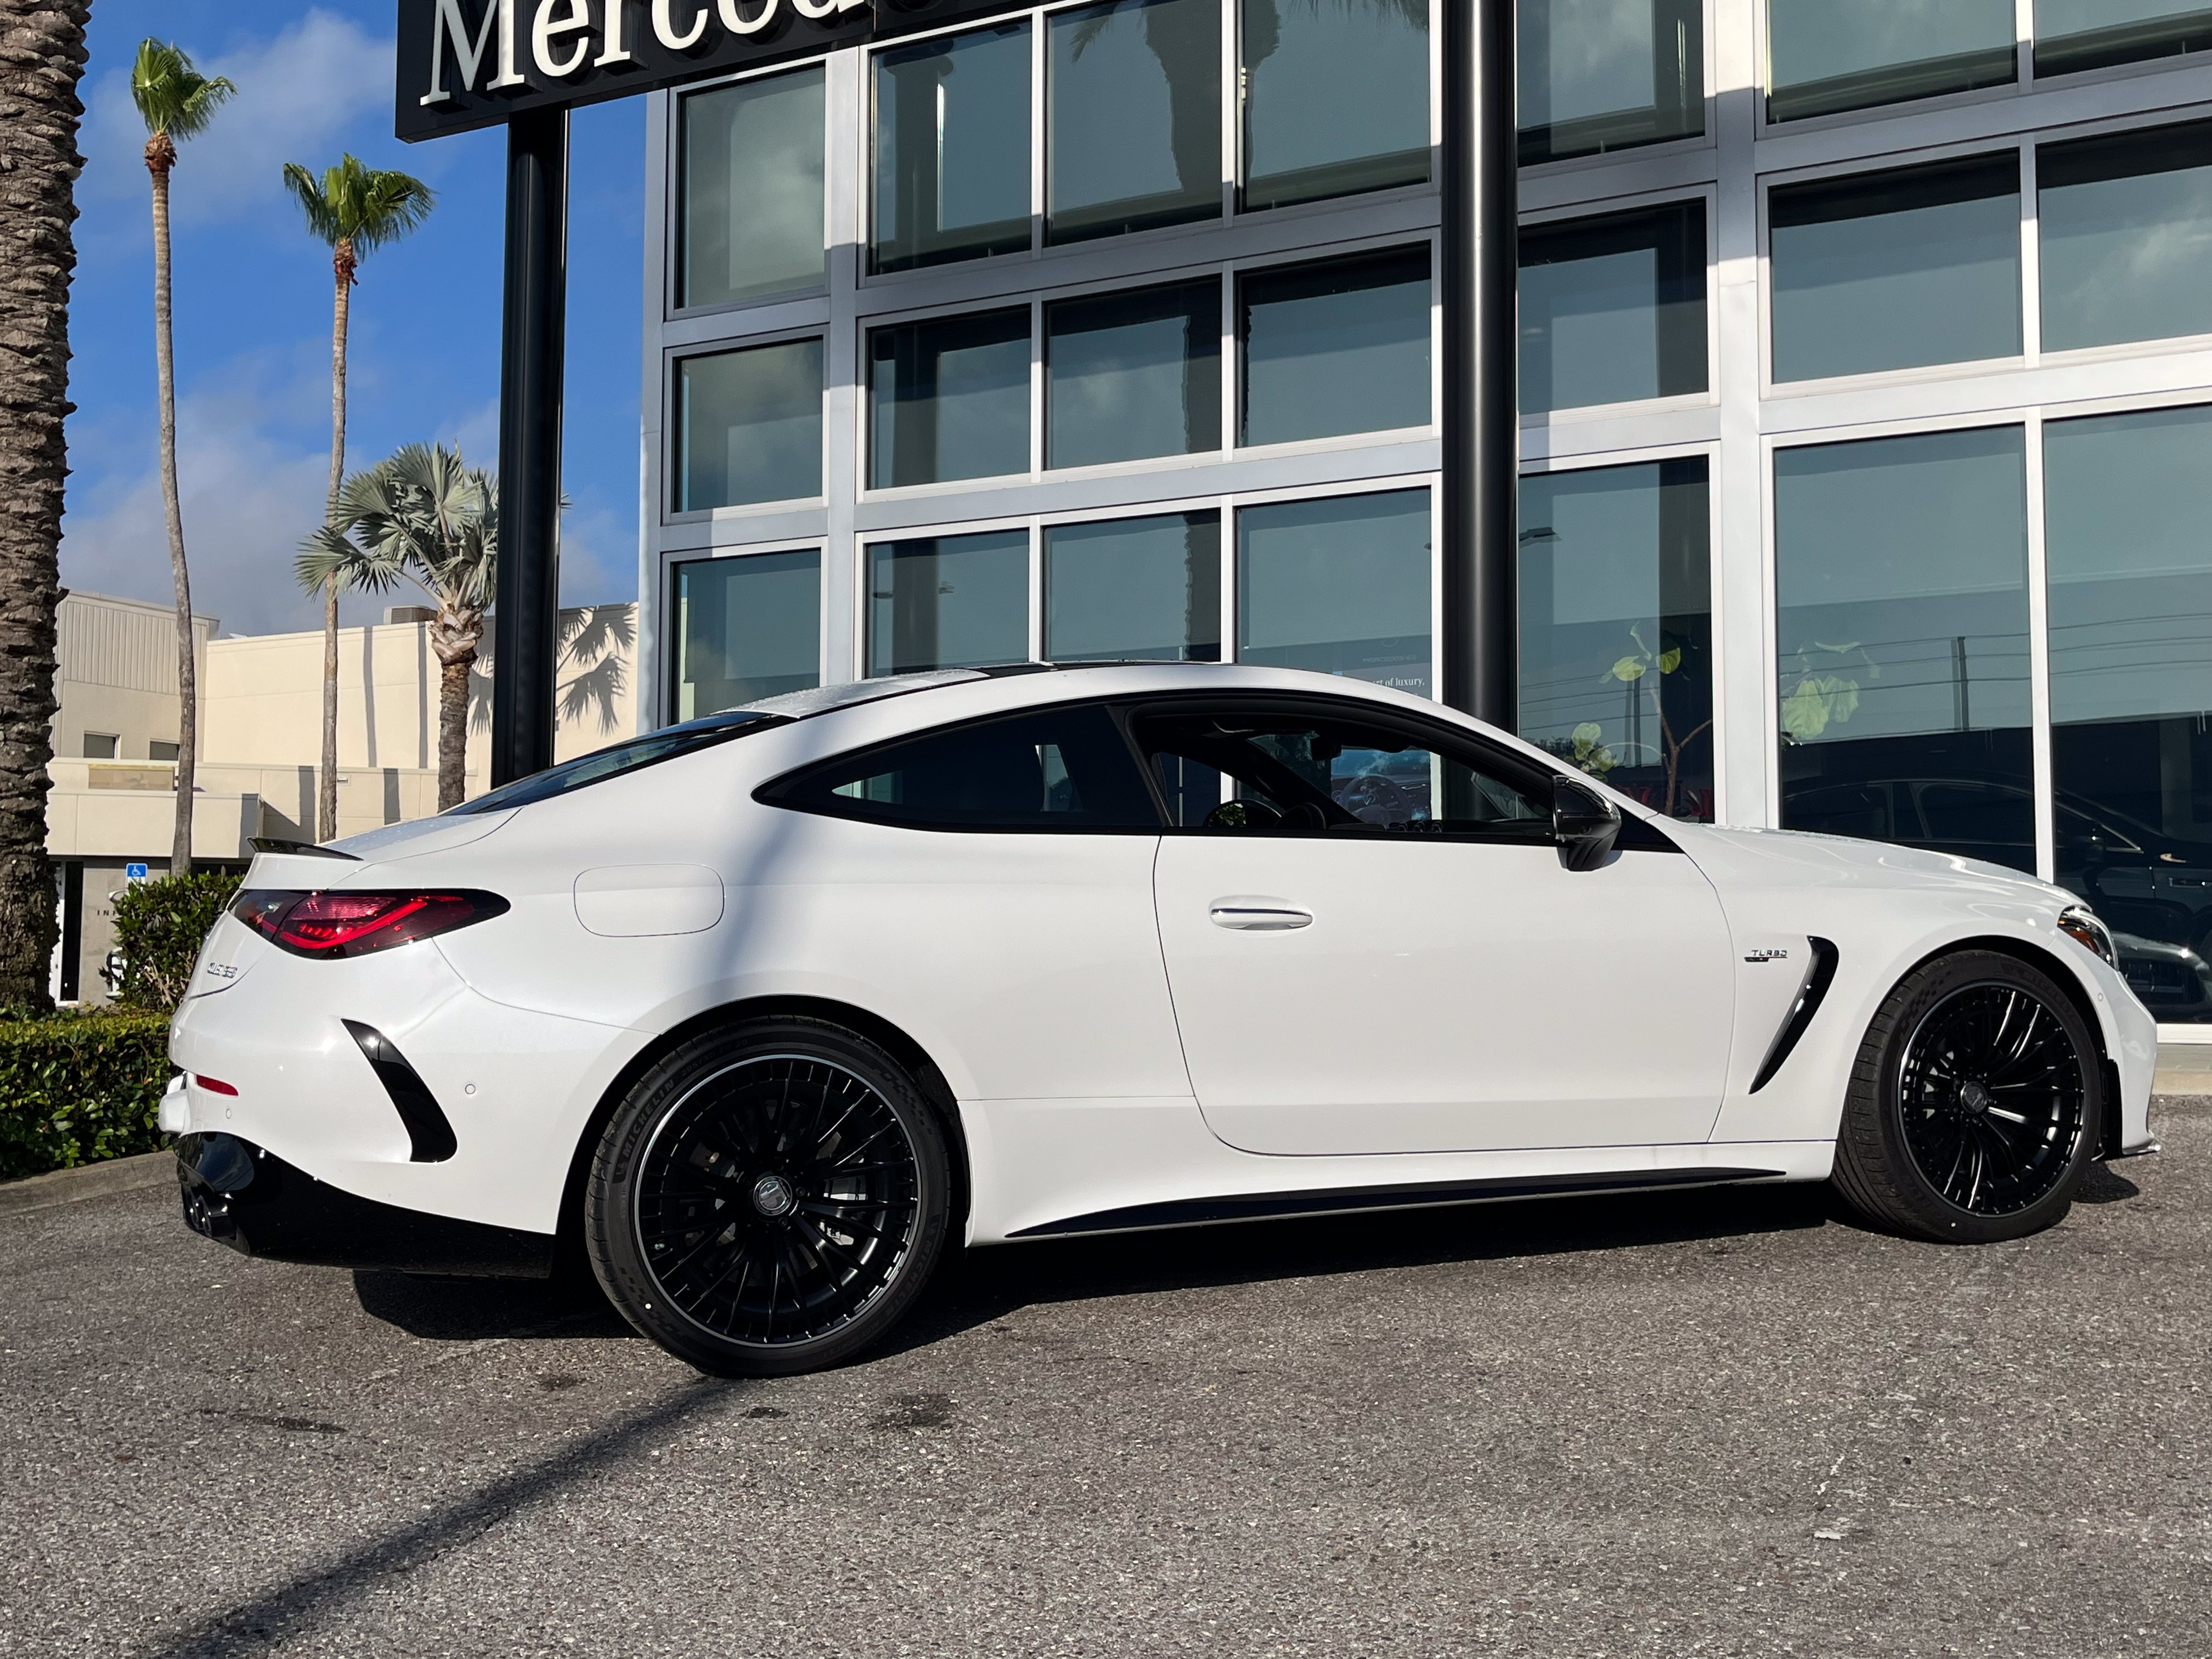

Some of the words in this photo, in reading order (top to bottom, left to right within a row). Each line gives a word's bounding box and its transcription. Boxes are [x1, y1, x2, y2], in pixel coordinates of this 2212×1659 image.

[1385, 678, 1395, 686] of
[1396, 678, 1425, 687] luxury,
[623, 1079, 675, 1158] MICHELIN
[885, 1242, 932, 1315] MICHELIN
